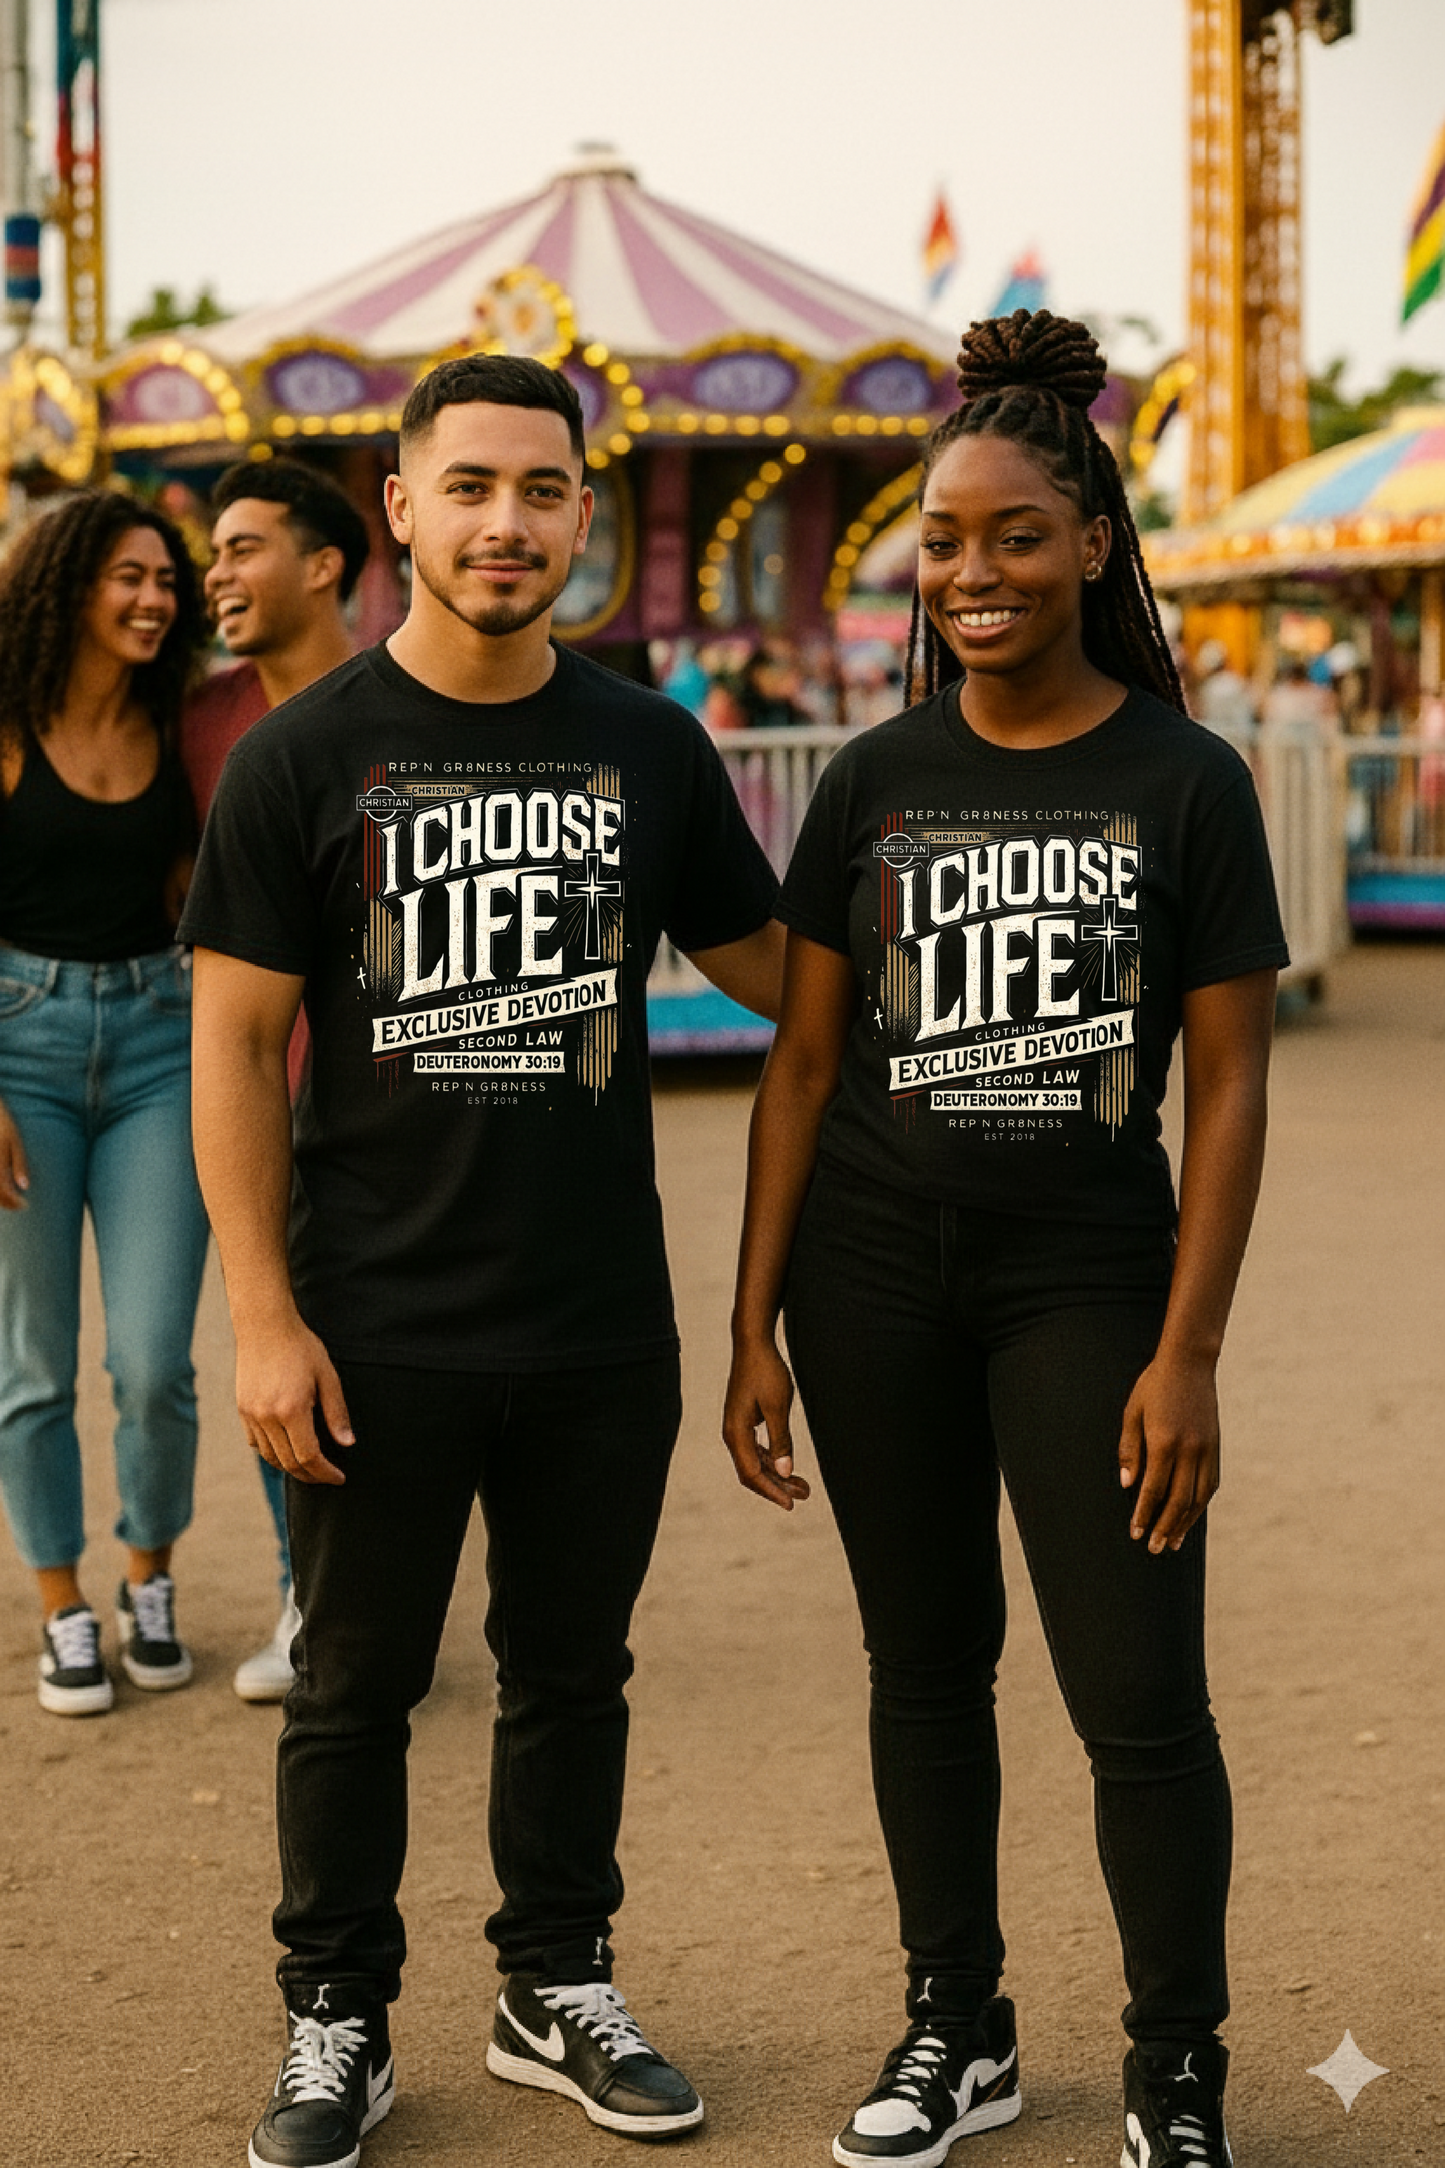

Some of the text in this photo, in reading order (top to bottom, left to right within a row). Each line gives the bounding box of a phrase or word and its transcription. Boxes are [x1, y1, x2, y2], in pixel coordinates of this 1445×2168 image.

[443, 762, 512, 773] GR8NESS
[518, 762, 593, 773] CLOTHING
[411, 785, 465, 795] CHRISTIAN
[359, 798, 409, 807] CHRISTIAN
[960, 810, 1028, 820] GR8NESS
[1035, 810, 1109, 821] CLOTHING
[381, 791, 622, 896] I CHOOSE
[928, 833, 982, 843] CHRISTIAN
[876, 845, 926, 854] CHRISTIAN
[898, 838, 1138, 940] I CHOOSE
[397, 866, 563, 1002] LIFE
[914, 910, 1080, 1042] LIFE
[458, 982, 529, 1001] CLOTHING
[381, 979, 607, 1045] EXCLUSIVE DEVOTION
[975, 1022, 1046, 1041] CLOTHING
[458, 1031, 563, 1049] SECOND LAW
[898, 1020, 1124, 1083] EXCLUSIVE DEVOTION
[416, 1055, 561, 1069] DEUTERONOMY 30:19
[975, 1070, 1080, 1088] SECOND LAW
[480, 1082, 546, 1092] GR8NESS
[467, 1097, 518, 1105] EST 2018
[933, 1093, 1078, 1107] DEUTERONOMY 30:19
[997, 1119, 1063, 1128] GR8NESS
[984, 1133, 1035, 1141] EST 2018
